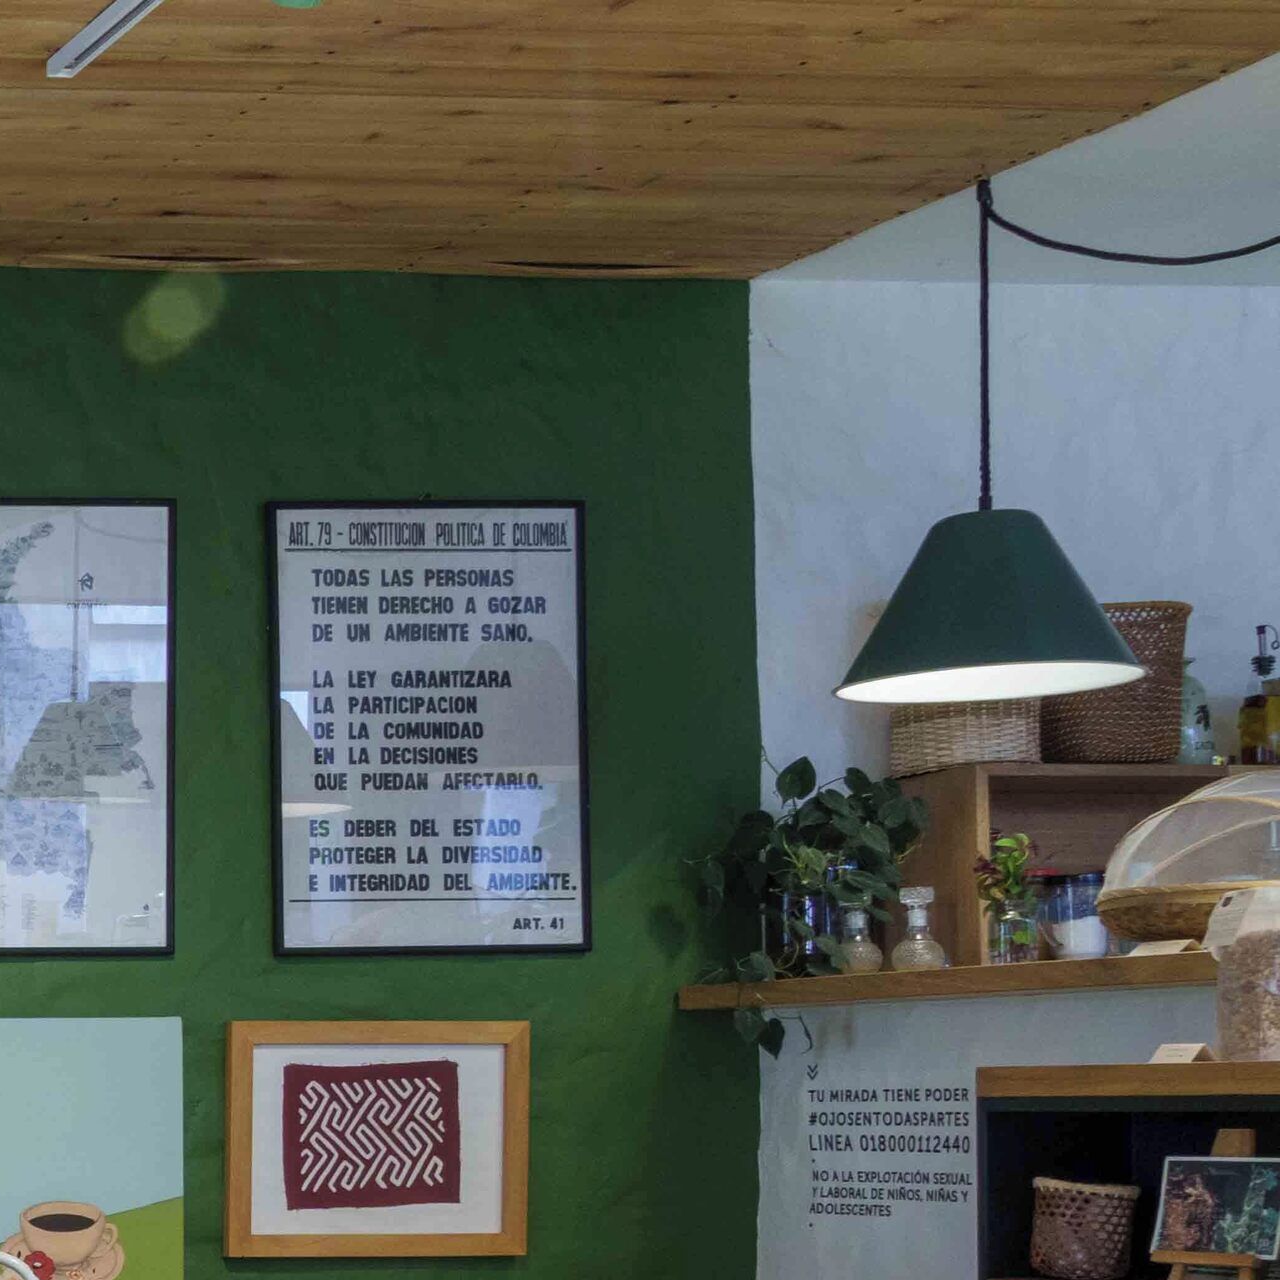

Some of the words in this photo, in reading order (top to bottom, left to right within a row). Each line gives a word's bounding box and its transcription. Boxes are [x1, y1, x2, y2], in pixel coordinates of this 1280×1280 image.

[289, 521, 314, 547] ART.
[317, 521, 332, 546] 79
[348, 521, 426, 546] CONSTITUCION
[436, 521, 486, 547] POLITICA
[492, 522, 506, 547] DE
[512, 521, 568, 547] COLOMBIA
[311, 568, 370, 588] TODAS
[380, 568, 414, 588] LAS
[424, 568, 514, 588] PERSONAS
[311, 596, 369, 615] TIENEN
[378, 596, 454, 615] DERECHO
[464, 596, 477, 615] A
[487, 596, 547, 616] GOZAR
[311, 623, 334, 643] DE
[346, 623, 371, 643] UN
[384, 623, 470, 643] AMBIENTE
[480, 623, 534, 644] SANO.
[312, 670, 334, 689] LA
[347, 670, 378, 689] LEY
[390, 670, 513, 689] GARANTIZARA
[313, 696, 335, 715] LA
[348, 695, 479, 715] PARTICIPACION
[314, 722, 335, 740] DE
[348, 722, 370, 740] LA
[383, 721, 484, 740] COMUNIDAD
[314, 747, 335, 765] EN
[348, 747, 371, 766] LA
[380, 746, 479, 765] DECISIONES
[314, 773, 348, 791] QUE
[361, 772, 429, 791] PUEDAN
[443, 772, 544, 791] AFECTARLO.
[309, 820, 330, 837] ES
[344, 819, 397, 837] DEBER
[410, 819, 439, 837] DEL
[453, 819, 522, 837] ESTADO
[309, 847, 396, 865] PROTEGER
[407, 847, 428, 865] LA
[442, 846, 544, 865] DIVERSIDAD
[309, 874, 318, 892] E
[330, 873, 431, 892] INTEGRIDAD
[444, 873, 473, 892] DEL
[488, 873, 578, 892] AMBIENTE.
[512, 918, 545, 931] ART.
[549, 917, 565, 931] 41
[808, 1090, 824, 1102] TU
[829, 1089, 878, 1102] MIRADA
[883, 1088, 920, 1102] TIENE
[925, 1088, 969, 1102] PODER
[808, 1111, 970, 1127] #OJOSENTODASPARTES
[809, 1134, 853, 1152] LINEA
[860, 1134, 971, 1154] 018000112440
[812, 1170, 829, 1182] NO
[832, 1171, 839, 1181] A
[841, 1171, 854, 1182] LA
[857, 1170, 930, 1184] EXPLOTACIÓN
[933, 1172, 973, 1186] SEXUAL
[812, 1187, 818, 1198] Y
[820, 1187, 867, 1199] LABORAL
[871, 1188, 885, 1200] DE
[887, 1187, 923, 1202] NIÑOS,
[926, 1187, 958, 1202] NIÑAS
[961, 1190, 969, 1203] Y
[809, 1202, 892, 1217] ADOLESCENTES
